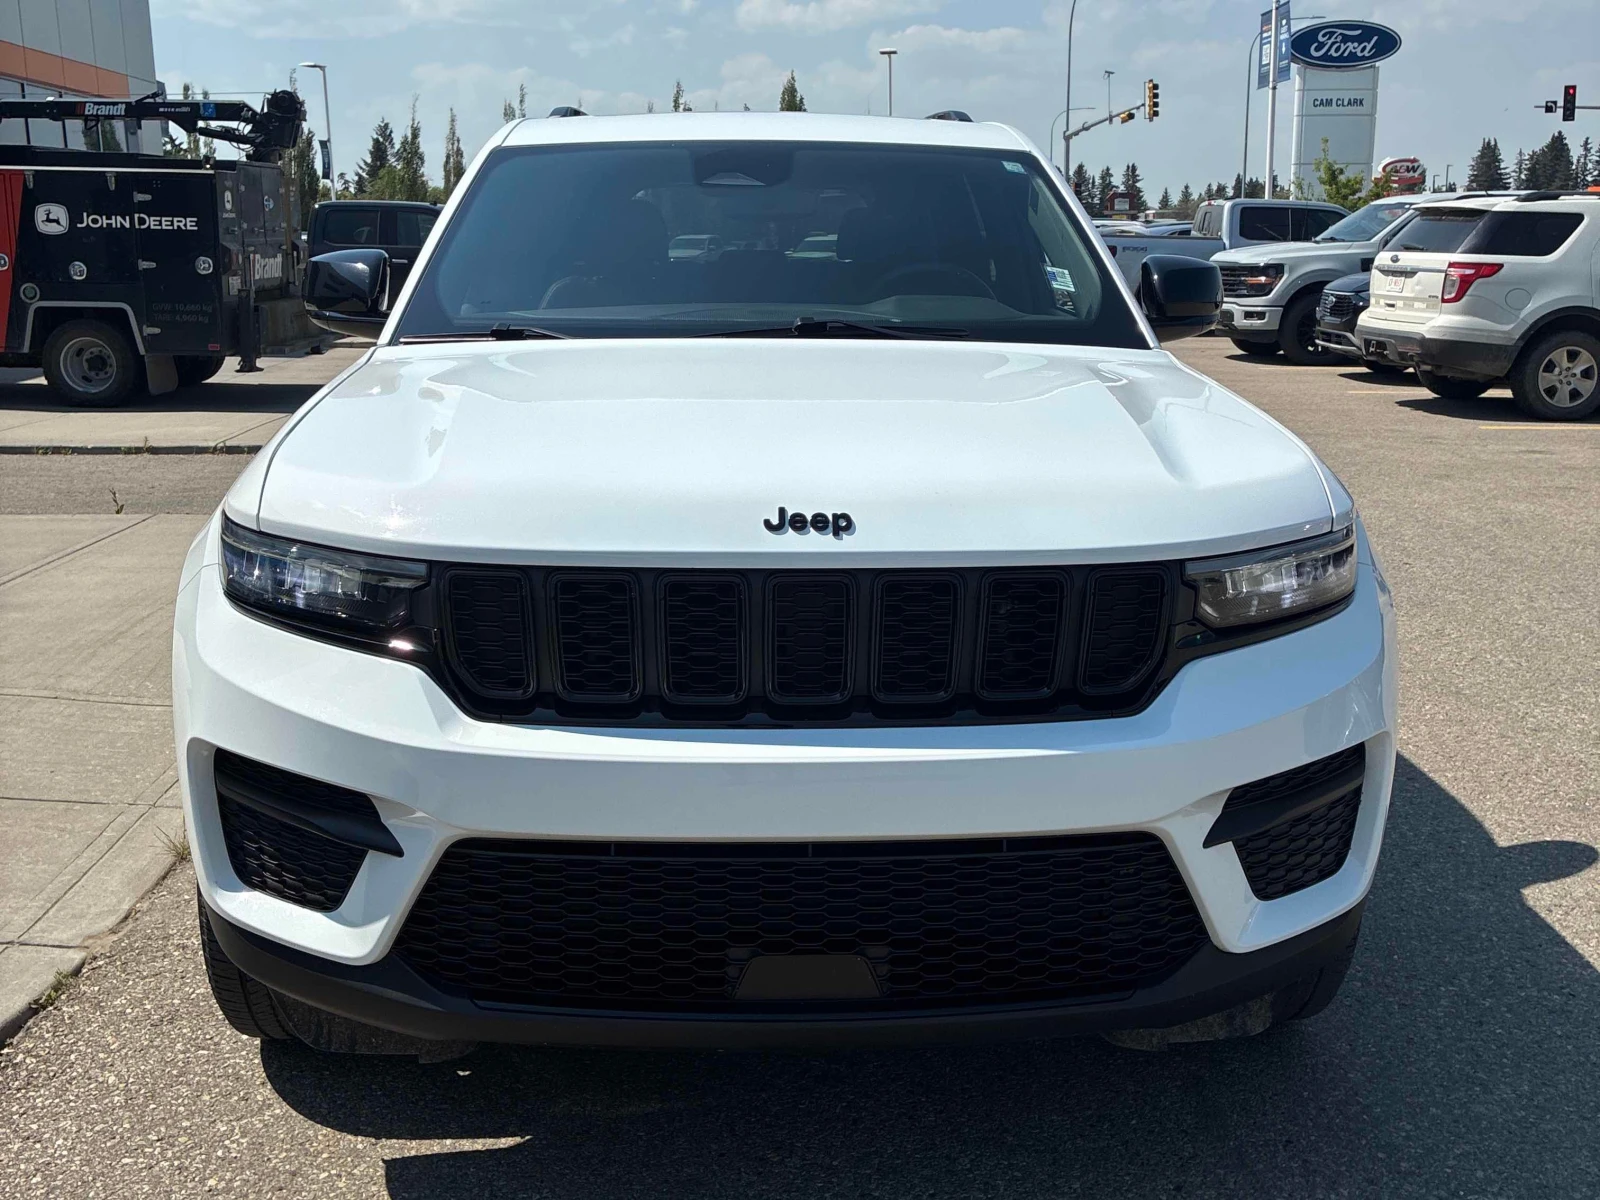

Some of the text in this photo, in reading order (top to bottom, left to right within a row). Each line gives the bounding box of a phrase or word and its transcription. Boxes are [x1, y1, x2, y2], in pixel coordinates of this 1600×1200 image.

[1310, 28, 1379, 57] Ford
[84, 102, 126, 116] Brandt
[1313, 98, 1365, 108] CAM CLARK
[76, 212, 198, 230] JOHN DEERE
[254, 253, 283, 280] Brandt
[763, 506, 854, 537] Jeep
